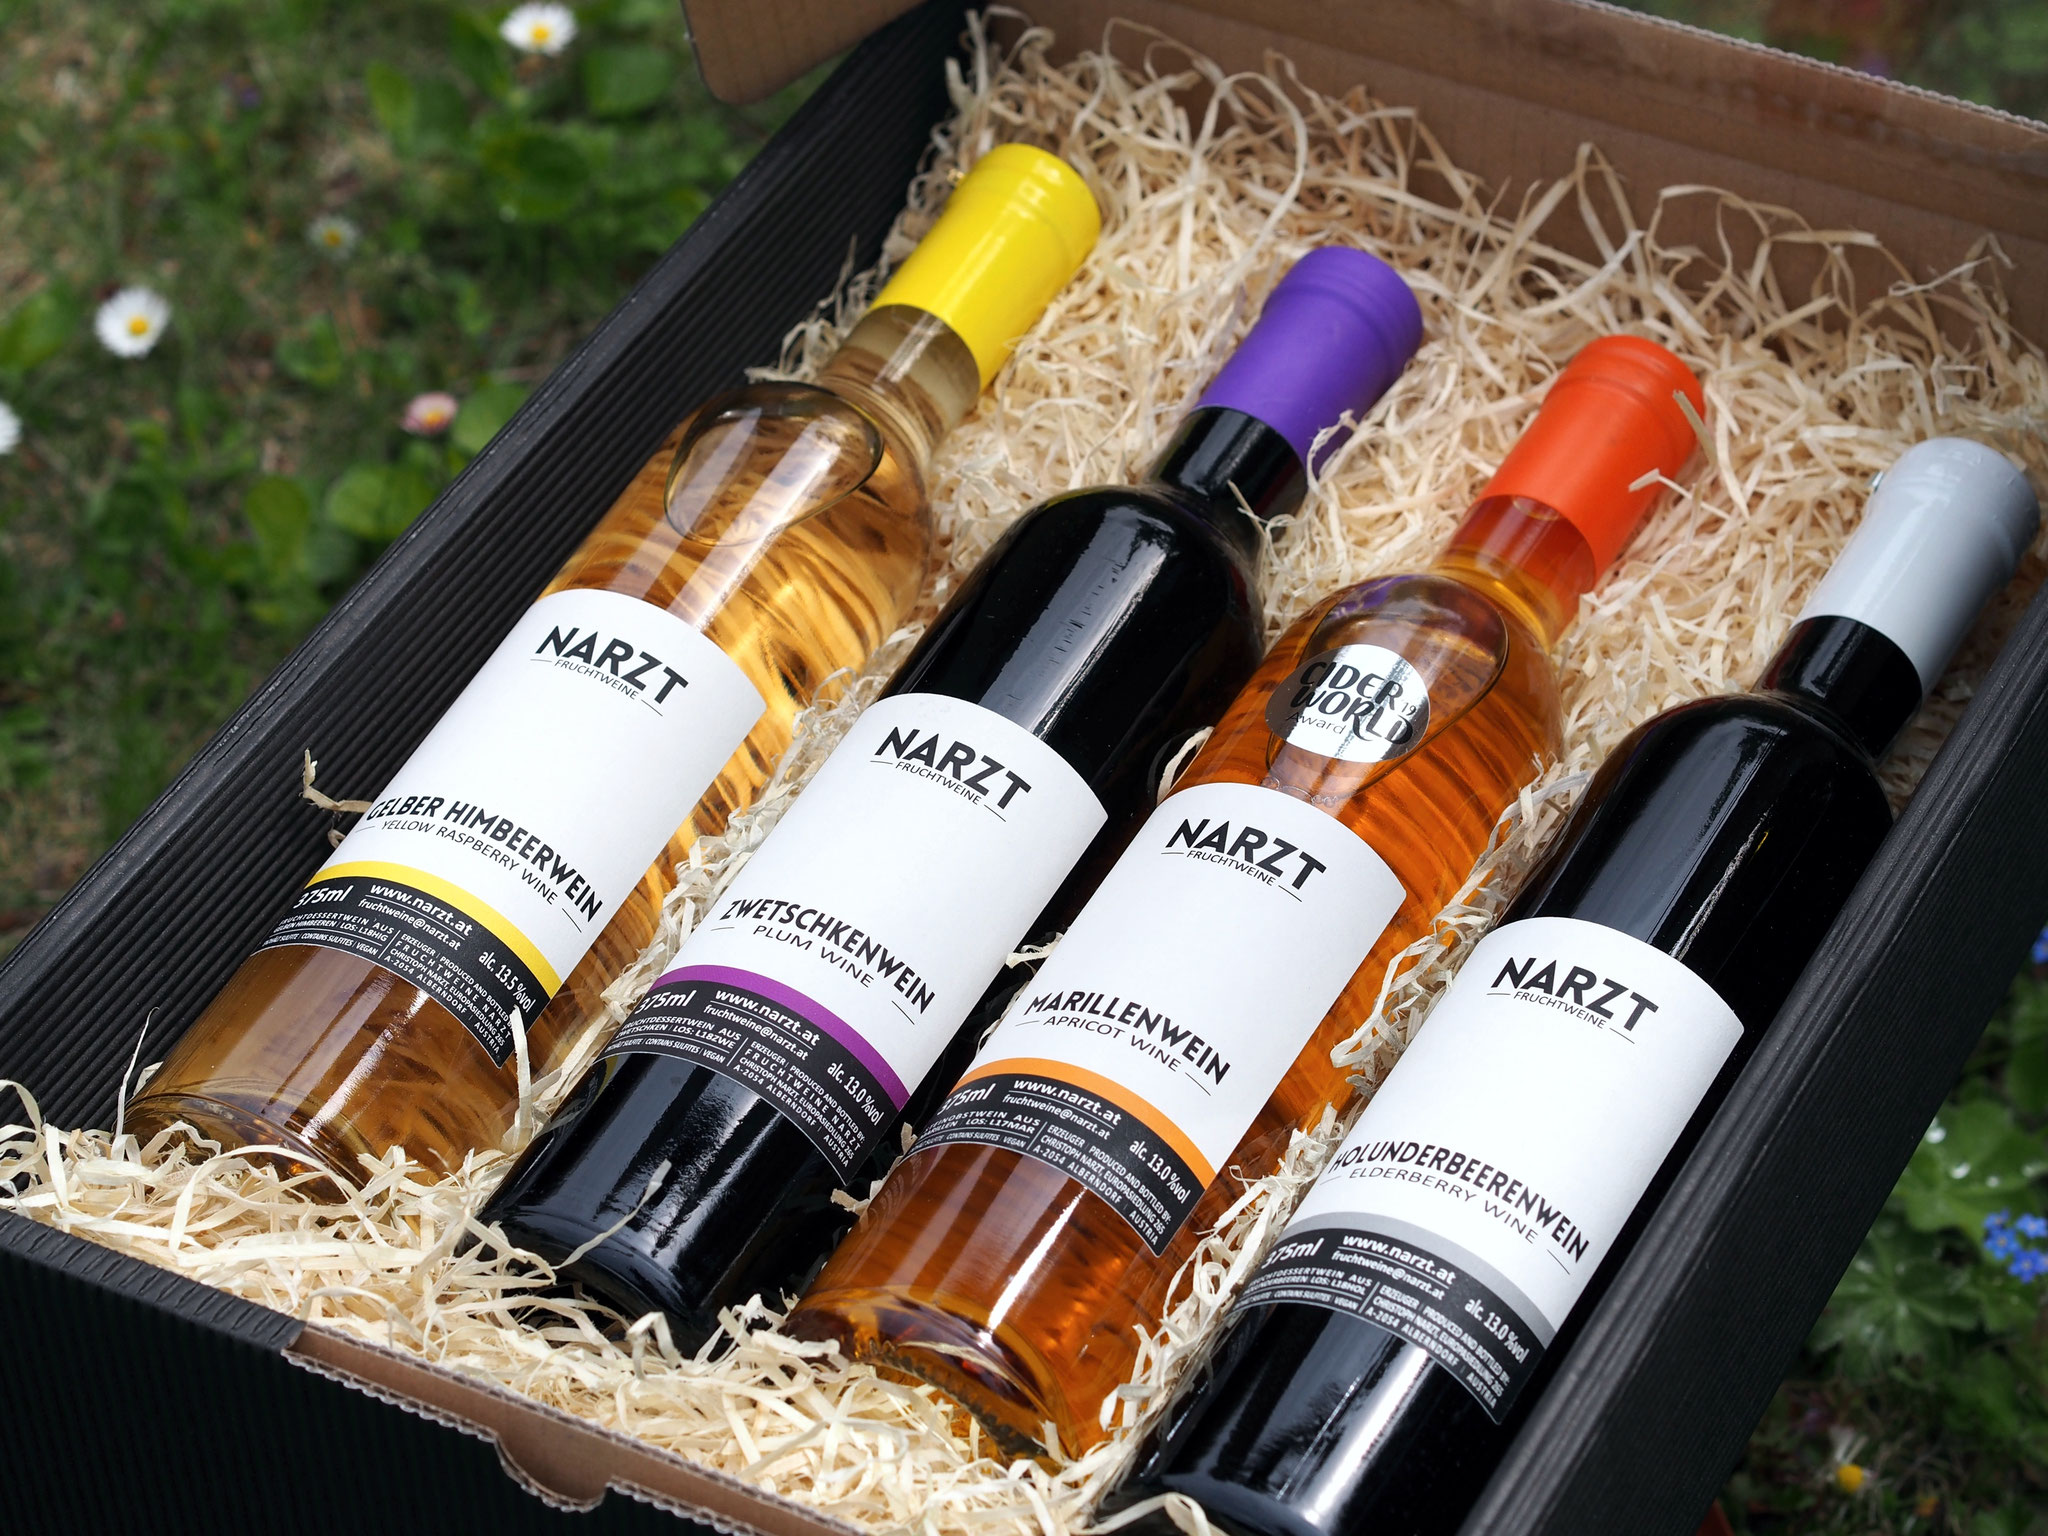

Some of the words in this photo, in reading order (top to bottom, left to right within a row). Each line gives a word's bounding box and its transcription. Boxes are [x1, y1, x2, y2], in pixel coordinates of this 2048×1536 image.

[535, 625, 689, 704] NARZT
[554, 659, 639, 700] FRUCHTWEINE
[1300, 661, 1403, 711] CIDER
[1285, 711, 1346, 735] Award
[1290, 685, 1413, 745] WORLD
[1401, 702, 1417, 716] 19
[874, 726, 1032, 809] NARZT
[895, 761, 982, 805] FRUCHTWEINE
[366, 796, 445, 821] GELBER
[443, 800, 603, 923] HIMBEERWEIN
[381, 820, 436, 833] YELLOW
[436, 826, 520, 871] RASPBERRY
[521, 868, 558, 905] WINE
[1165, 818, 1327, 890] NARZT
[1186, 850, 1276, 886] FRUCHTWEINE
[293, 885, 354, 909] 375ml
[370, 884, 473, 937] www.narzt.at
[340, 922, 359, 932] LOS:
[358, 926, 389, 942] L18HIG
[358, 898, 461, 951] fruchtweine@narzt.at
[373, 922, 395, 934] AUS
[355, 942, 379, 955] VEGAN
[390, 949, 428, 973] CHRISTOPH
[478, 951, 496, 972] alc.
[494, 964, 518, 991] 13.5
[720, 898, 935, 1015] ZWETSCHKENWEIN
[752, 925, 813, 950] PLUM
[820, 946, 874, 988] WINE
[401, 934, 436, 957] ERZEUGER
[440, 956, 474, 988] PRODUCED
[473, 982, 488, 997] AND
[486, 993, 509, 1022] BOTTLED
[1491, 957, 1659, 1031] NARZT
[384, 955, 414, 975] A-2054
[416, 974, 467, 1014] ALBERNDORF
[474, 1022, 500, 1054] AUSTRIA
[634, 990, 697, 1014] 375ml
[715, 990, 821, 1046] www.narzt.at
[1513, 991, 1606, 1029] FRUCHTWEINE
[672, 1025, 695, 1035] LOS:
[695, 1030, 736, 1049] L18ZWE
[703, 1005, 809, 1061] fruchtweine@narzt.at
[718, 1028, 742, 1041] AUS
[1024, 991, 1231, 1085] MARILLENWEIN
[1043, 1016, 1125, 1038] APRICOT
[1130, 1035, 1181, 1072] WINE
[702, 1050, 726, 1064] VEGAN
[739, 1056, 778, 1083] CHRISTOPH
[751, 1041, 787, 1066] ERZEUGER
[790, 1065, 825, 1096] PRODUCED
[823, 1094, 838, 1109] AND
[835, 1103, 859, 1134] BOTTLED
[827, 1062, 843, 1084] alc.
[844, 1076, 867, 1103] 13.0
[937, 1083, 996, 1115] 375ml
[1013, 1080, 1122, 1126] www.narzt.at
[733, 1065, 764, 1085] A-2054
[766, 1084, 817, 1127] ALBERNDORF
[823, 1134, 850, 1168] AUSTRIA
[989, 1119, 1036, 1134] L17MAR
[1002, 1094, 1110, 1140] fruchtweine@narzt.at
[1013, 1114, 1040, 1126] AUS
[1002, 1136, 1026, 1148] VEGAN
[1040, 1135, 1081, 1160] CHRISTOPH
[1129, 1140, 1148, 1161] alc.
[1147, 1153, 1172, 1180] 13.0
[1047, 1124, 1086, 1148] ERZEUGER
[1089, 1146, 1126, 1176] PRODUCED
[1124, 1172, 1141, 1189] AND
[1137, 1182, 1164, 1214] BOTTLED
[1032, 1144, 1066, 1165] A-2054
[1067, 1162, 1122, 1204] ALBERNDORF
[1129, 1210, 1158, 1245] AUSTRIA
[1328, 1141, 1589, 1263] HOLUNDERBEERENWEIN
[1349, 1167, 1477, 1202] ELDERBERRY
[1484, 1200, 1538, 1244] WINE
[1261, 1237, 1324, 1269] 375ml
[1331, 1250, 1446, 1300] fruchtweine@narzt.at
[1342, 1235, 1456, 1285] www.narzt.at
[1348, 1274, 1373, 1287] AUS
[1464, 1299, 1484, 1321] alc.
[1483, 1312, 1509, 1340] 13.0
[1401, 1324, 1460, 1367] ALBERNDORF
